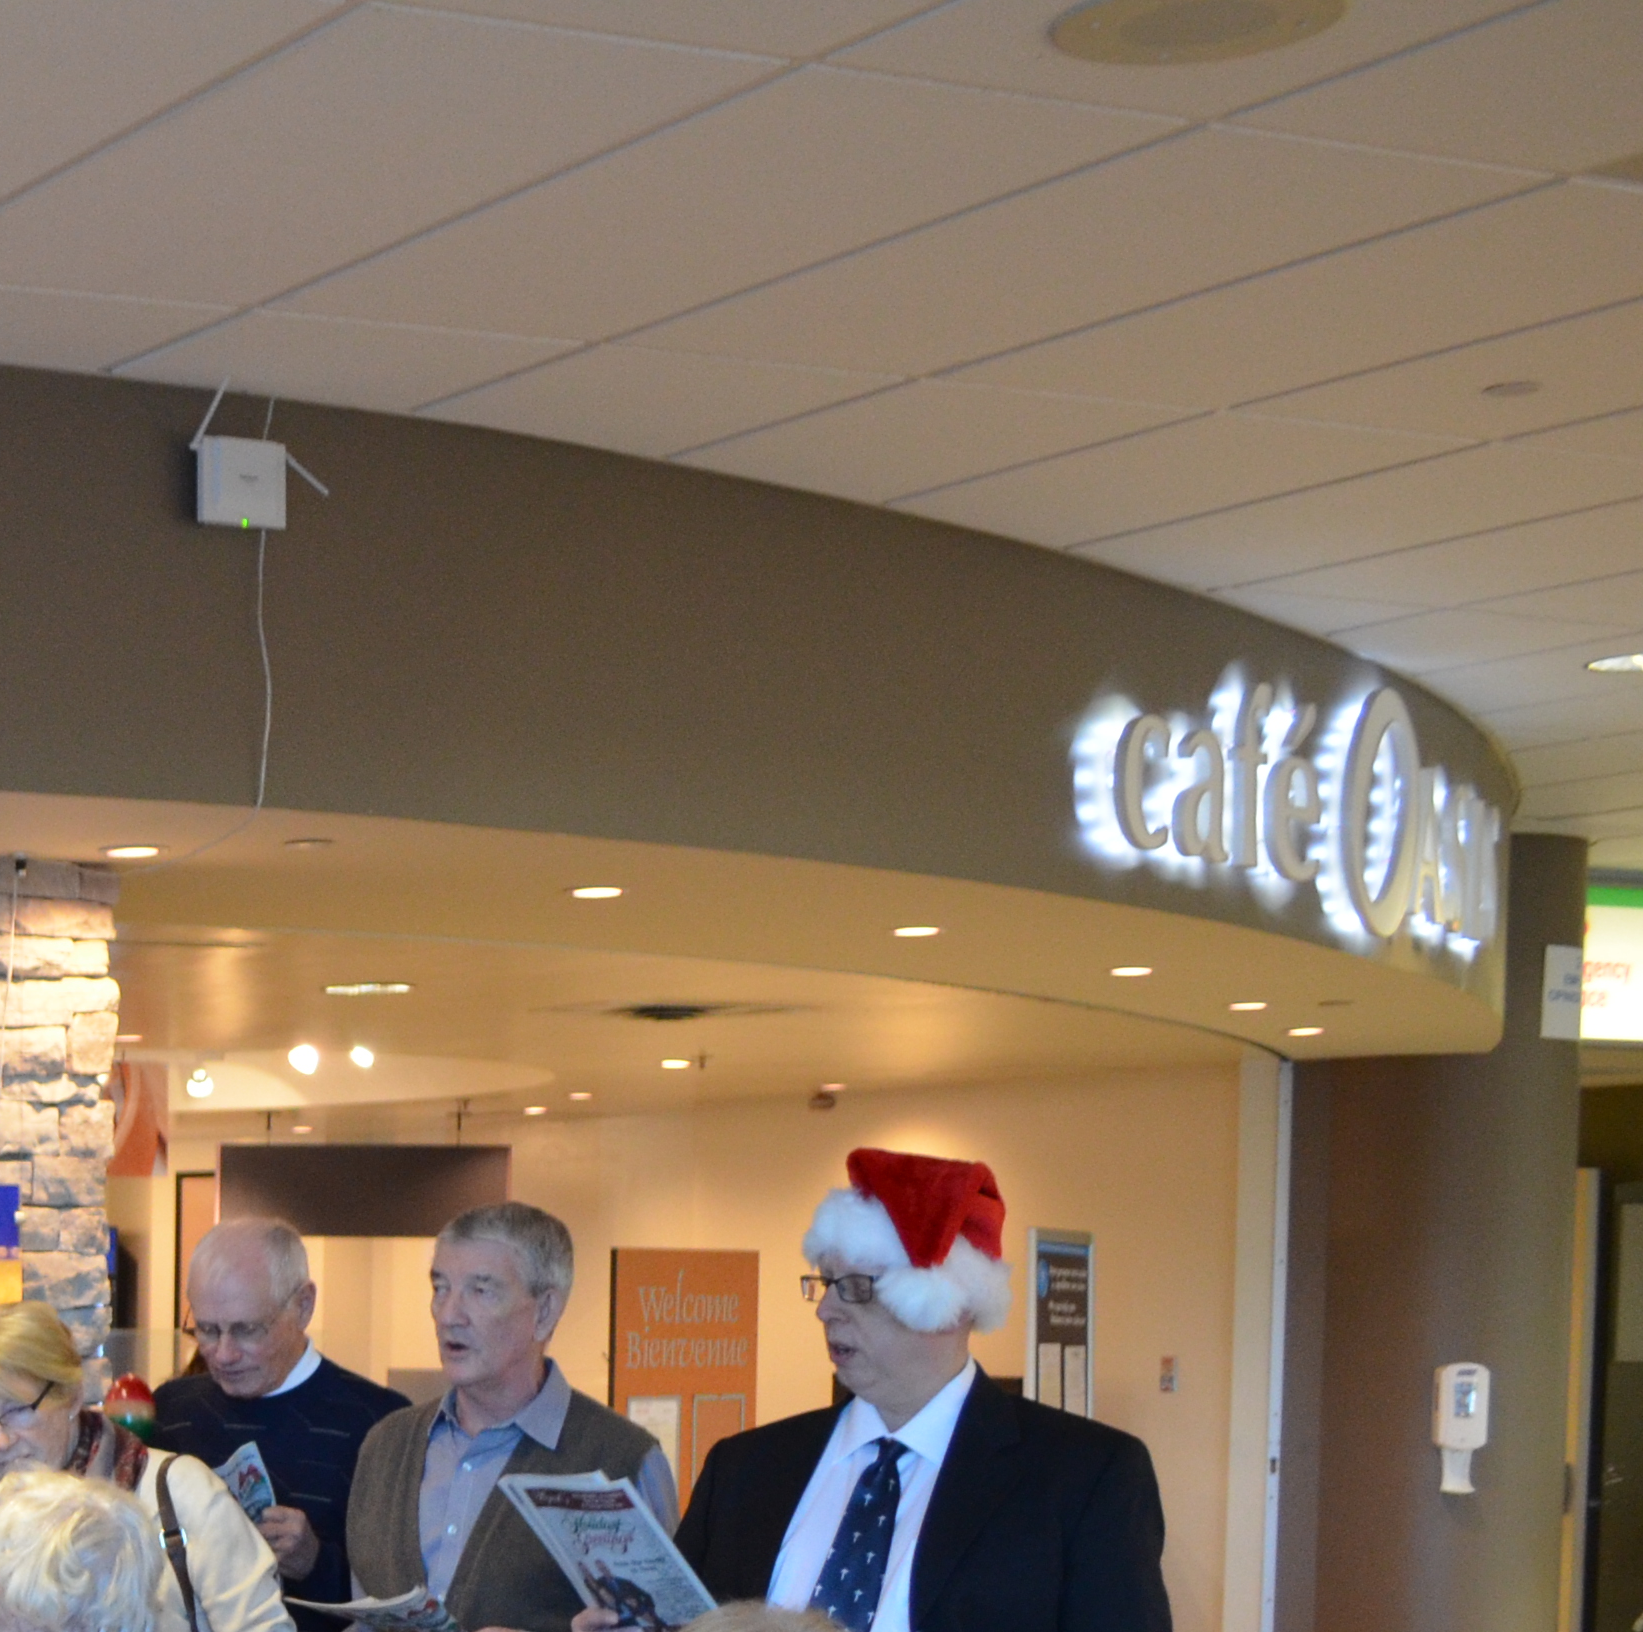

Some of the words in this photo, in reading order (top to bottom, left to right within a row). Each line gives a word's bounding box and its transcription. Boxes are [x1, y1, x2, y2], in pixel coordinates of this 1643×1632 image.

[1115, 681, 1320, 883] café
[638, 1267, 741, 1324] Welcome
[625, 1326, 749, 1370] Bienvenue
